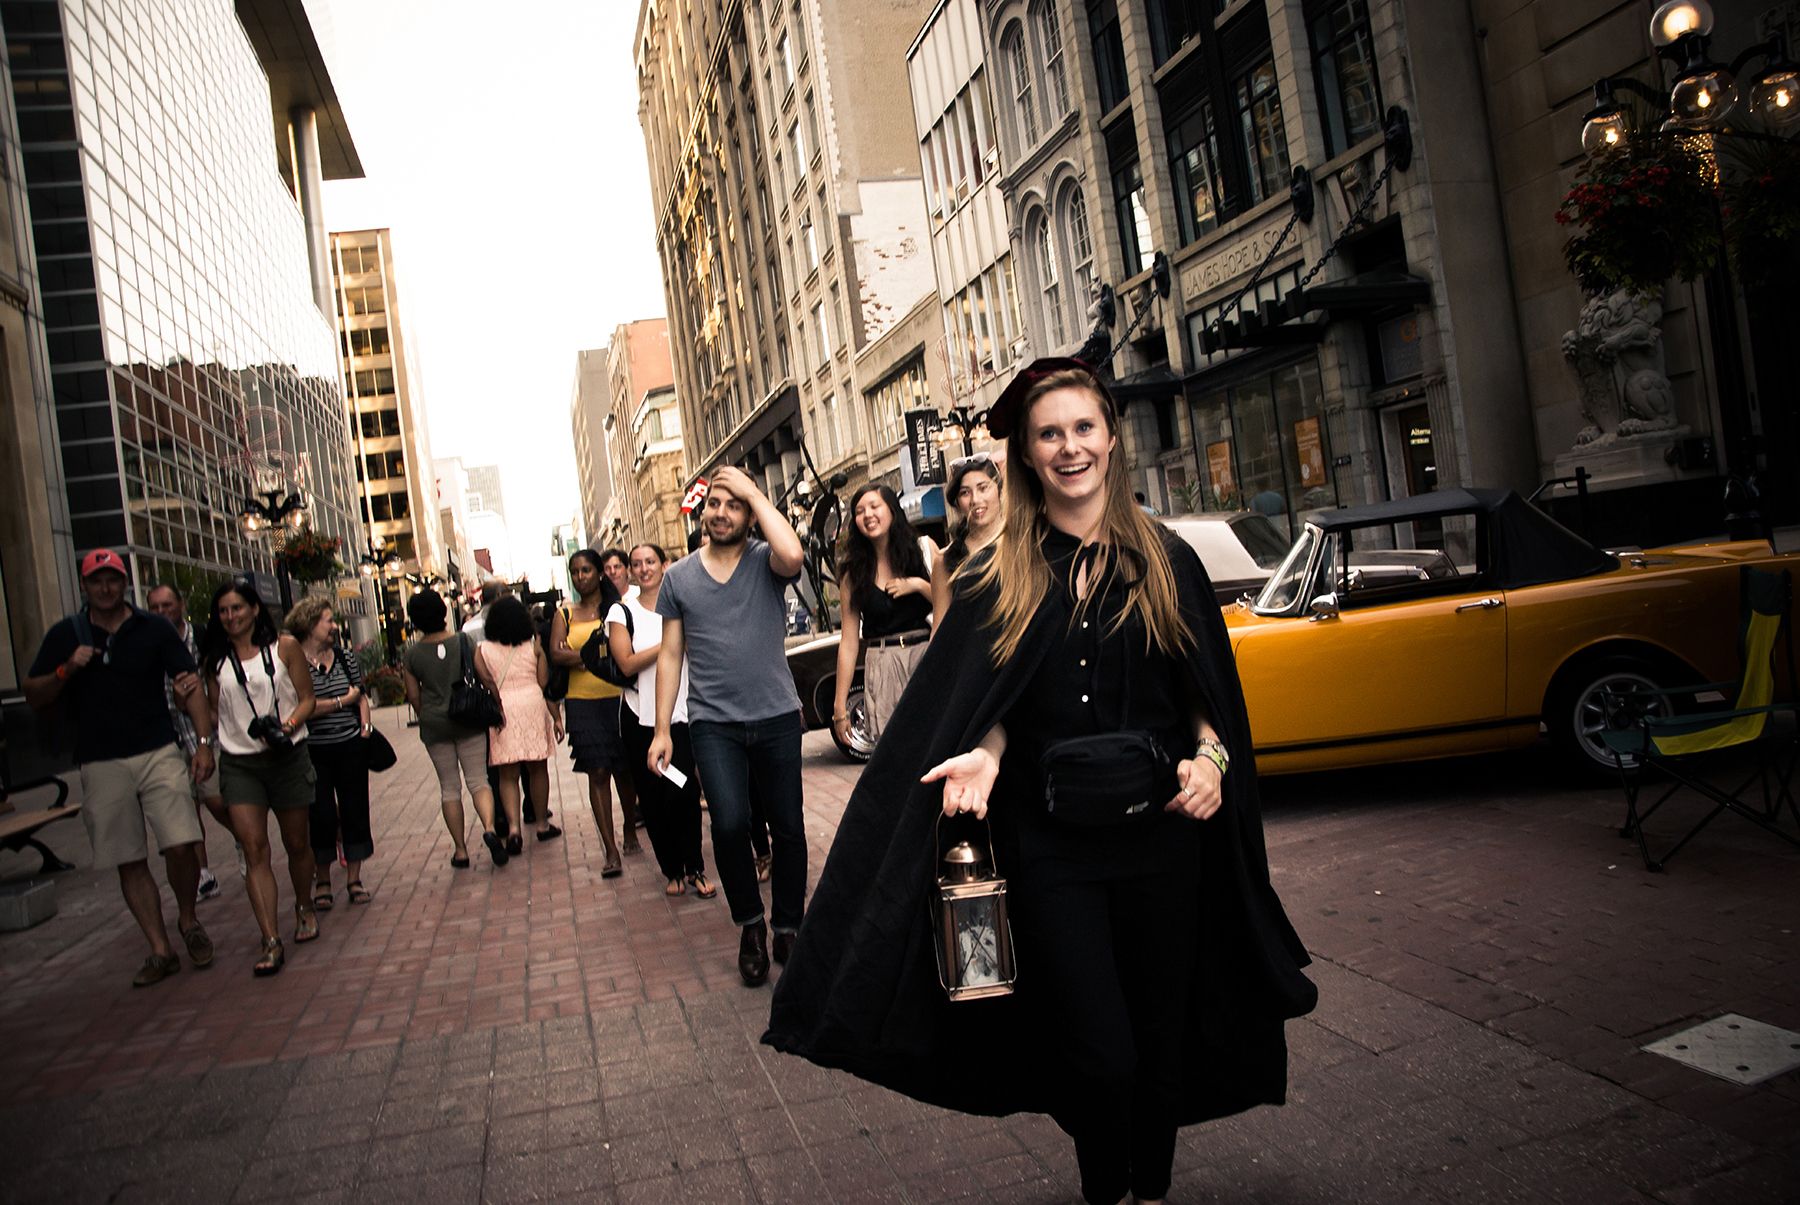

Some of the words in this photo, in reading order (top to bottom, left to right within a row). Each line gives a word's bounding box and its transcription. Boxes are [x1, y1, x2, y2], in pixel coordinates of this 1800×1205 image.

[1186, 263, 1220, 297] JAMES
[1220, 246, 1251, 279] HOPE
[1252, 241, 1262, 262] &
